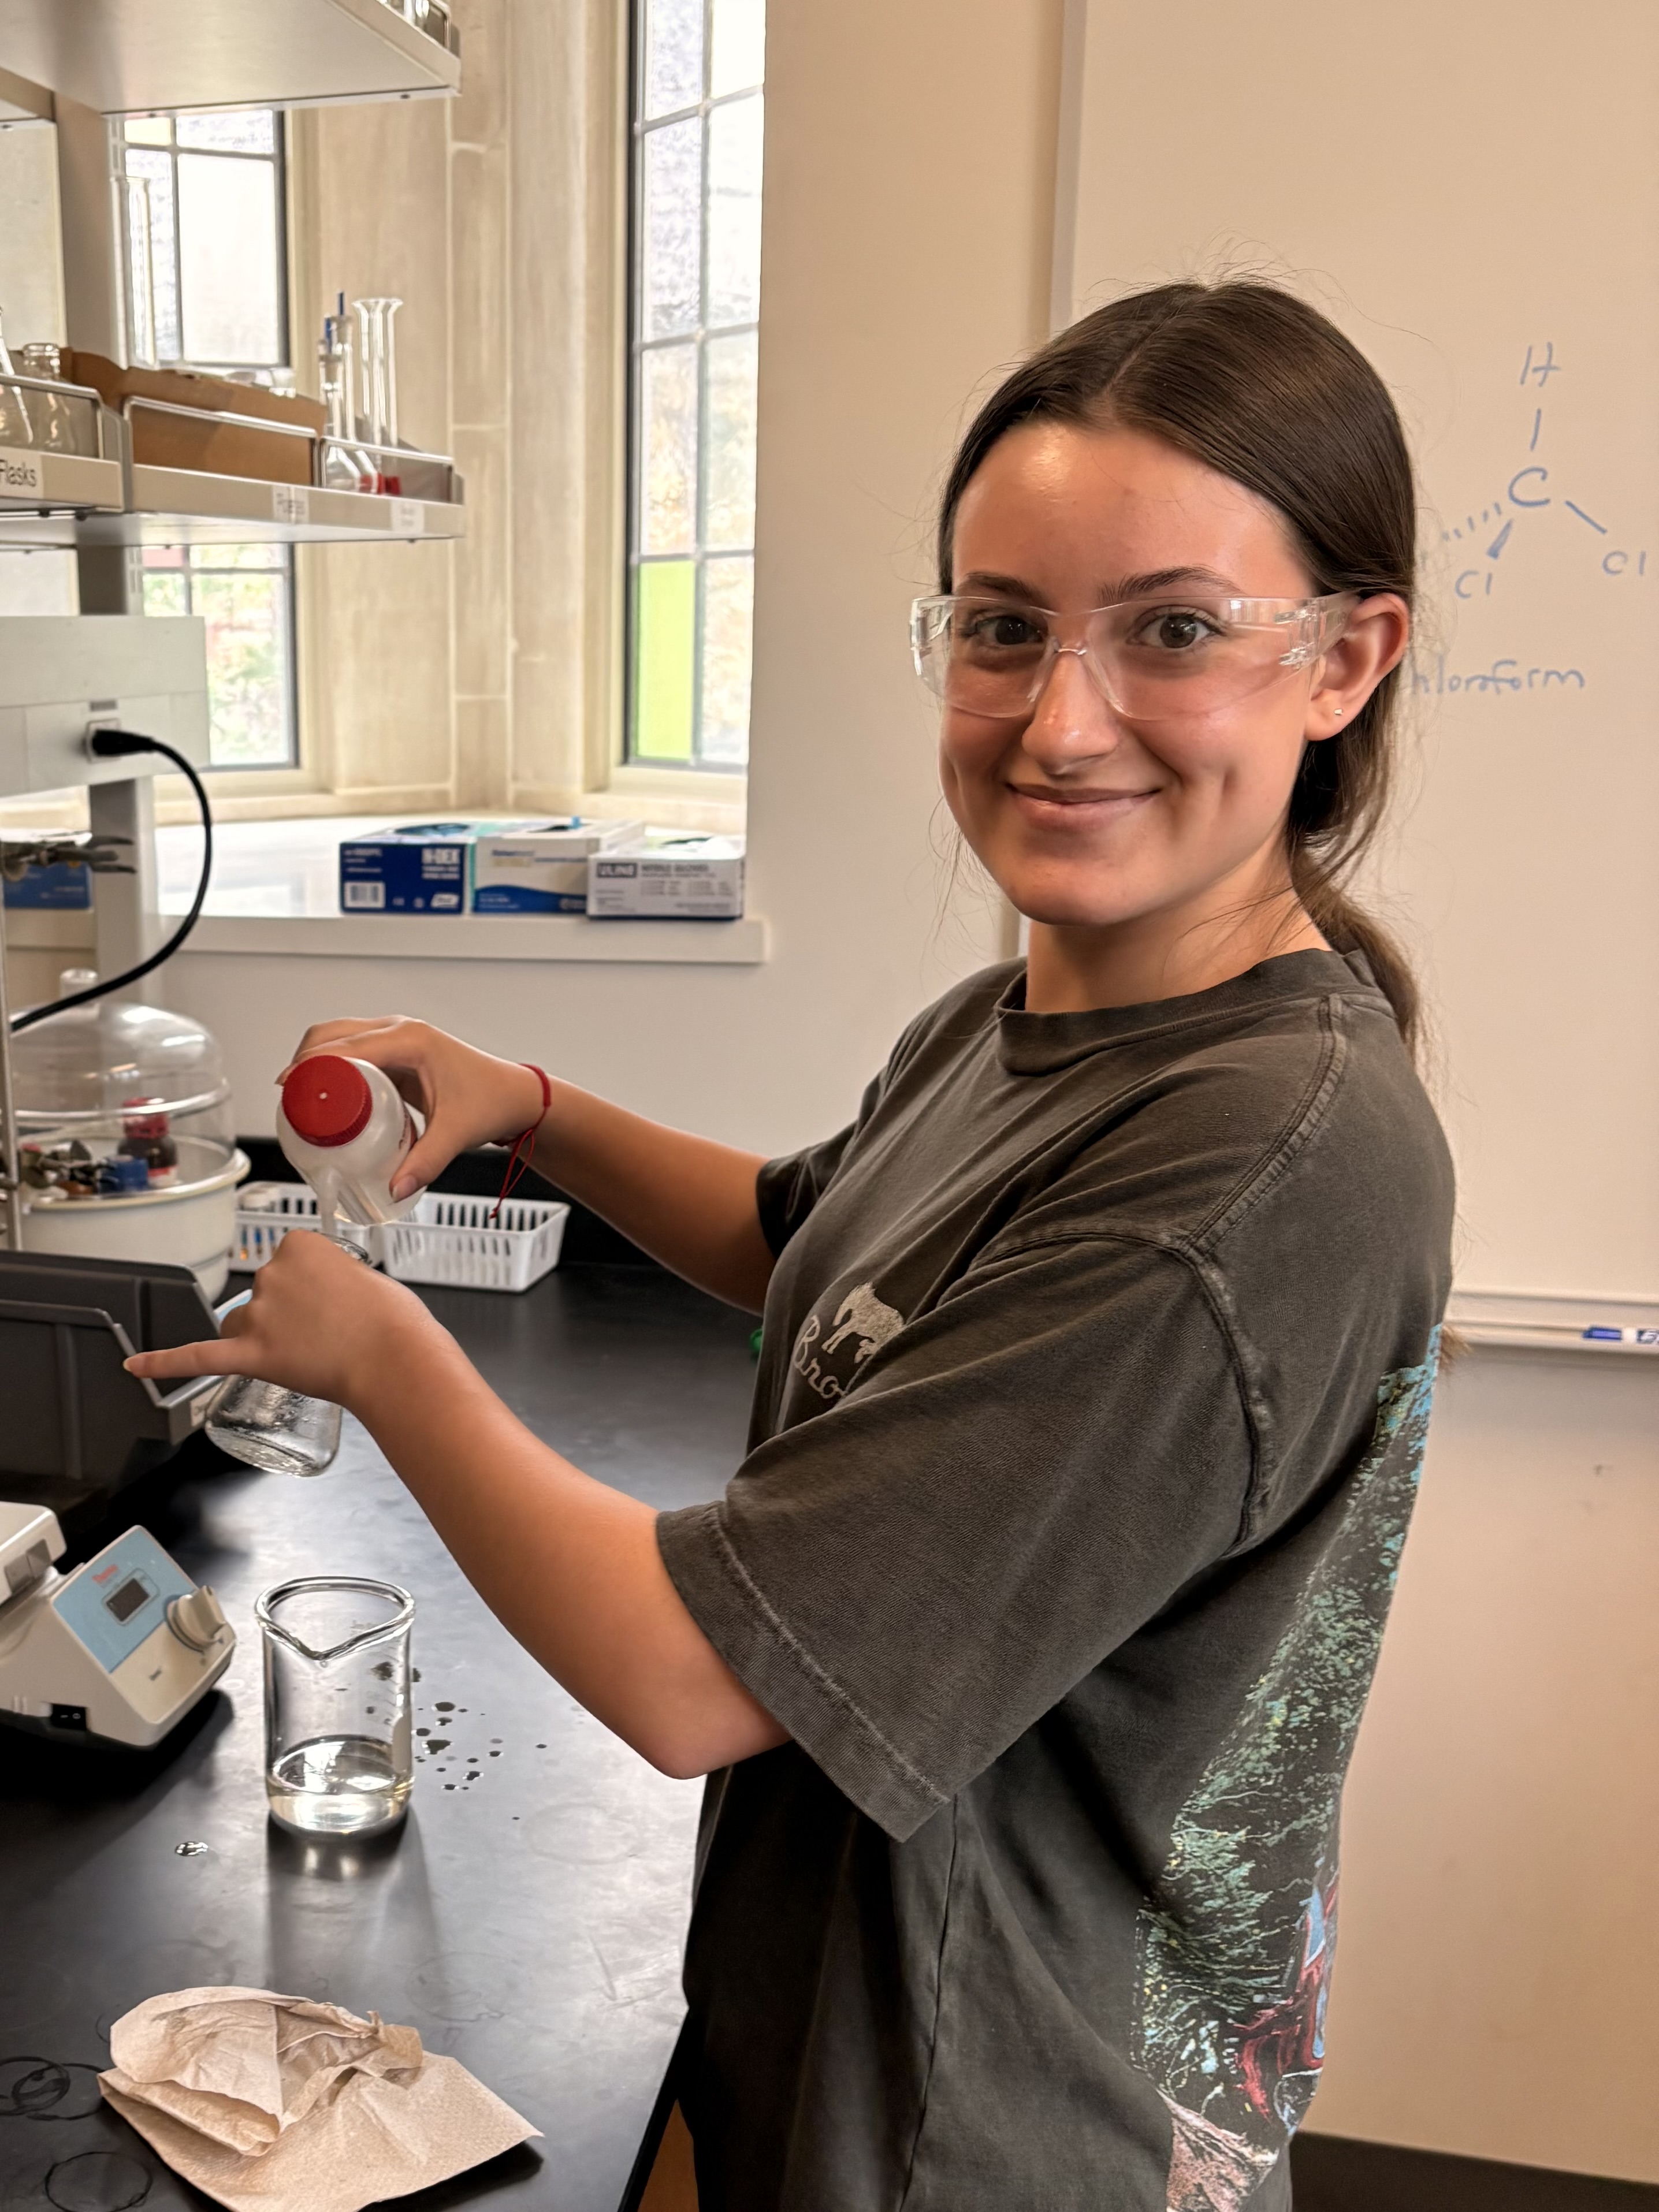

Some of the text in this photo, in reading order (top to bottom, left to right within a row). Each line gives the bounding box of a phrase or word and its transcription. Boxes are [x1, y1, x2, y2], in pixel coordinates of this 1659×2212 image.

[1520, 341, 1561, 387] H
[1508, 466, 1551, 508] C
[1411, 653, 1585, 695] hloroform
